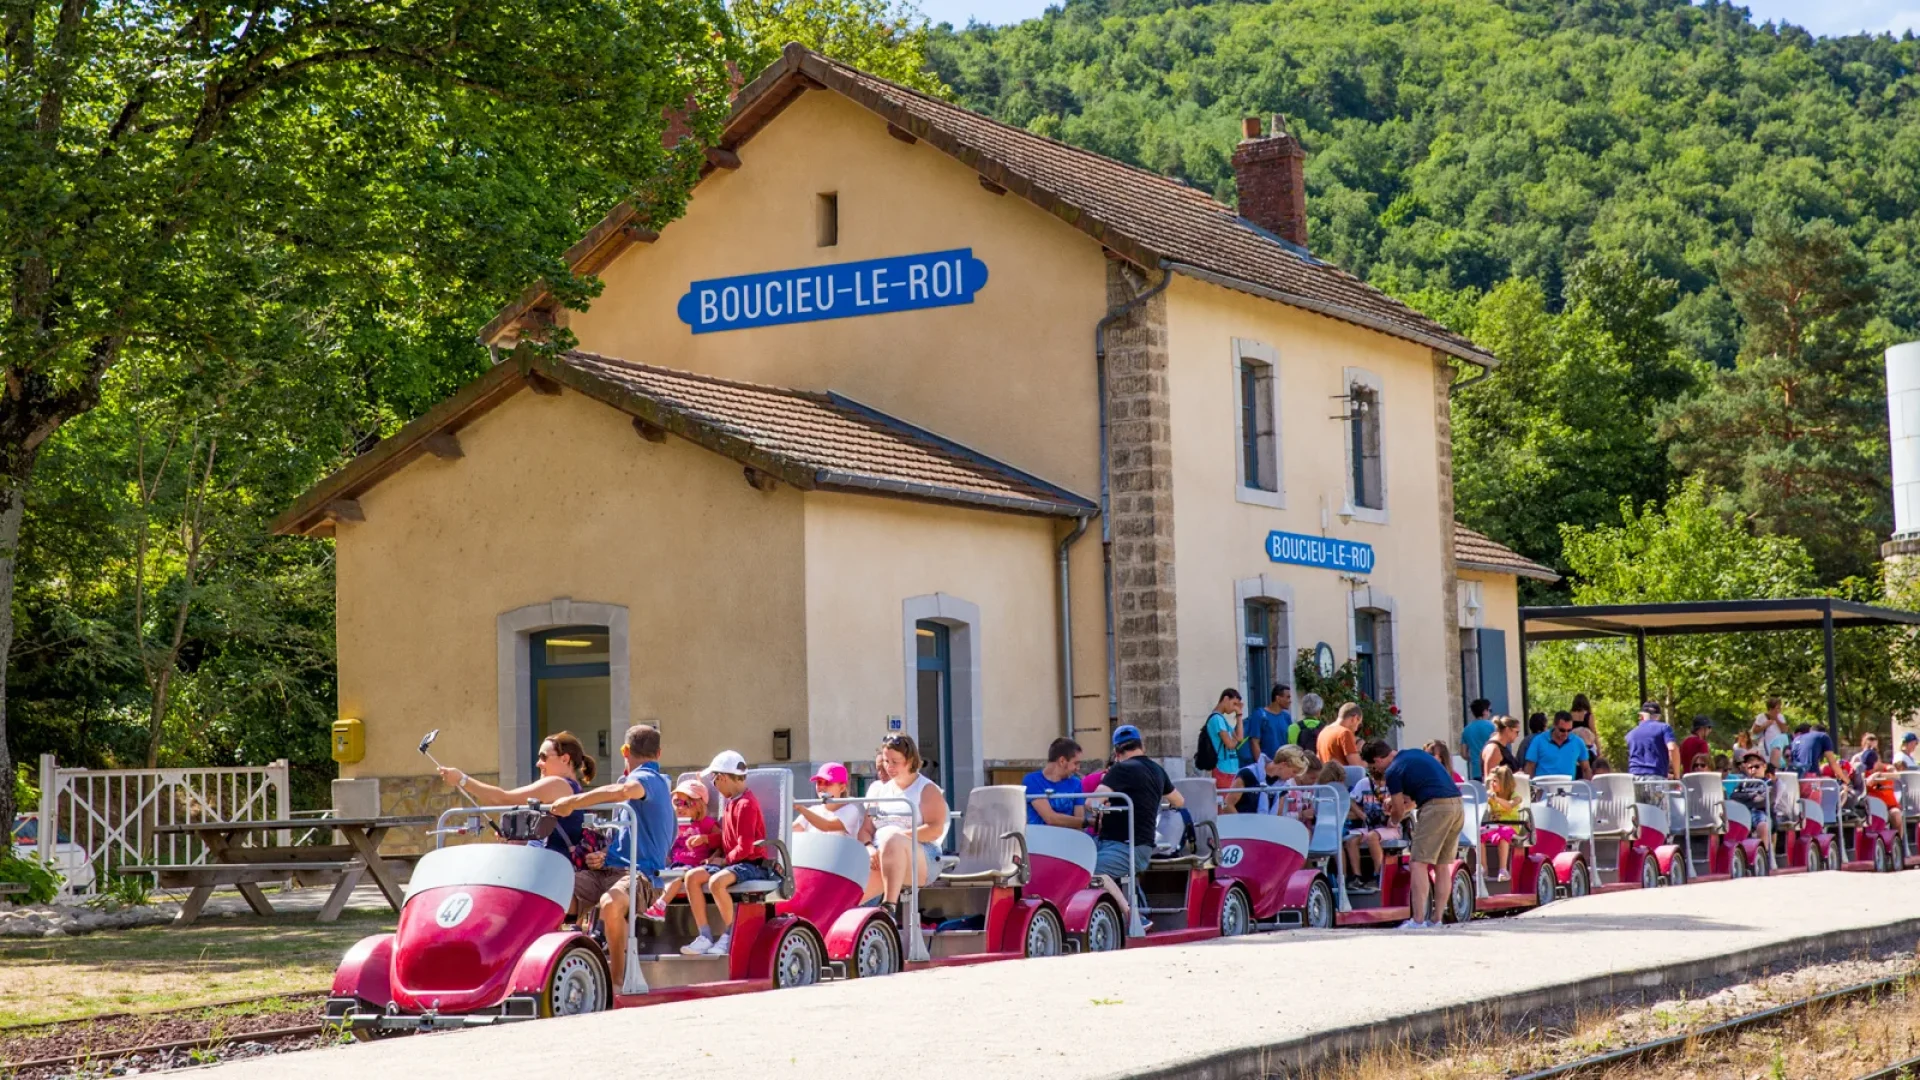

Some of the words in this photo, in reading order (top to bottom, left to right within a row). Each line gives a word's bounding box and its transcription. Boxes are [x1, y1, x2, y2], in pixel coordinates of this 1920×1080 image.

[700, 259, 963, 325] BOUCIEU-LE-ROI
[1272, 535, 1370, 569] BOUCIEU-LE-ROI
[1222, 847, 1240, 865] 48
[440, 898, 470, 922] 47
